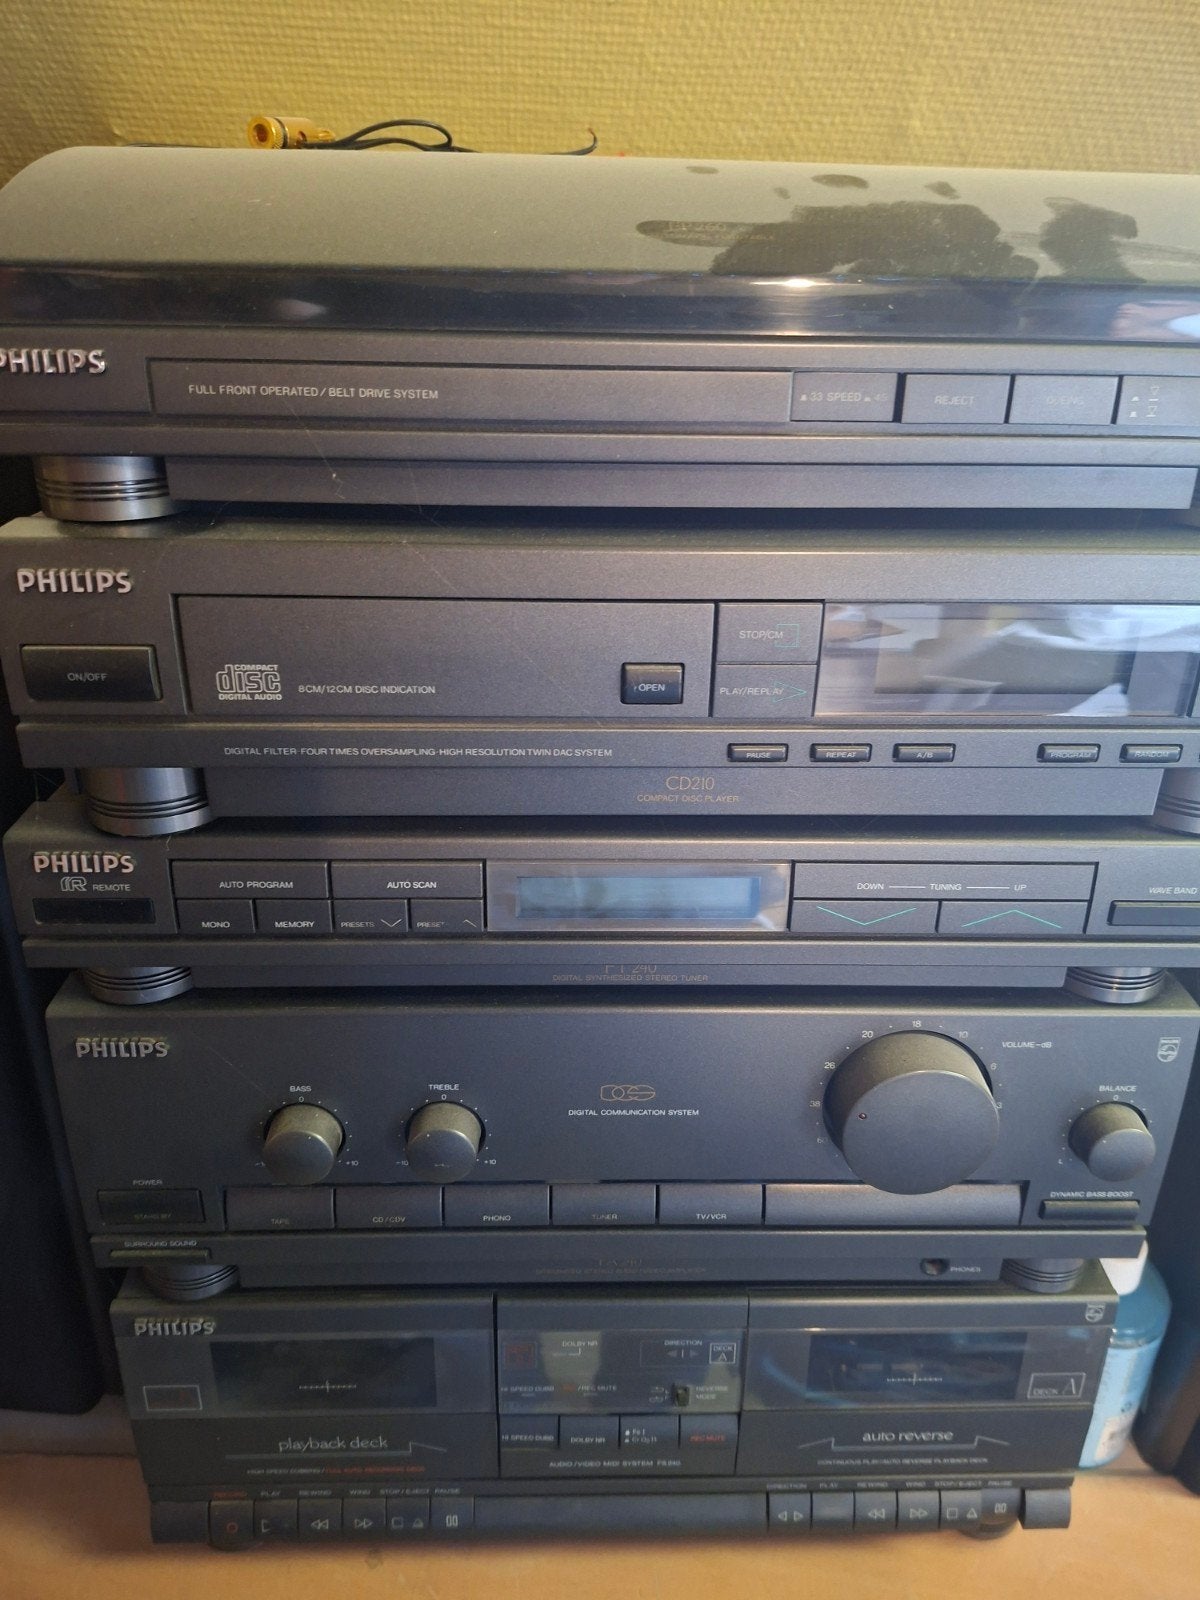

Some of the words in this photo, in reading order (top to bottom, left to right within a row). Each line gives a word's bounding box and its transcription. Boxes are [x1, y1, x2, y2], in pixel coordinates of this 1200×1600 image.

[188, 385, 216, 395] FULL
[219, 385, 257, 396] FRONT
[359, 388, 391, 398] DRIVE
[394, 389, 439, 399] SYSTEM
[827, 392, 862, 402] SPEED
[934, 395, 975, 406] REJECT
[17, 569, 132, 594] PHILIPS
[739, 630, 784, 640] STOP/CM
[67, 672, 108, 682] ON/OFF
[355, 685, 379, 694] DISC
[380, 685, 436, 694] INDICATION
[638, 683, 665, 692] OPEN
[218, 693, 252, 701] DIGITAL
[254, 693, 282, 701] AUDIO
[224, 747, 261, 756] DIGITAL
[330, 748, 359, 756] TIMES
[465, 748, 525, 757] RESOLUTION
[527, 748, 552, 757] TWIN
[553, 748, 572, 757] DAC
[574, 748, 613, 757] SYSTEM
[746, 751, 771, 759] PAUSE
[665, 776, 715, 790] CD210
[637, 794, 679, 802] COMPACT
[705, 795, 740, 803] PLAYER
[33, 852, 135, 873] PHILIPS
[92, 884, 131, 892] REMOTE
[219, 881, 244, 889] AUTO
[246, 881, 294, 889] PROGRAM
[387, 881, 411, 889] AUTO
[412, 881, 437, 889] SCAN
[857, 882, 885, 890] DOWN
[930, 883, 962, 891] TUNING
[1149, 886, 1173, 894] WAVE
[1174, 887, 1198, 895] BAND
[912, 1020, 922, 1028] 18
[861, 1030, 874, 1039] 20
[958, 1031, 969, 1039] 10
[74, 1039, 169, 1058] PHILIPS
[824, 1061, 836, 1070] 26
[428, 1083, 460, 1091] TREBLE
[482, 1214, 512, 1222] PHONO
[134, 1320, 217, 1336] PHILIPS
[862, 1431, 896, 1442] auto
[898, 1431, 954, 1442] reverse
[278, 1436, 346, 1452] playback
[350, 1435, 388, 1449] deck
